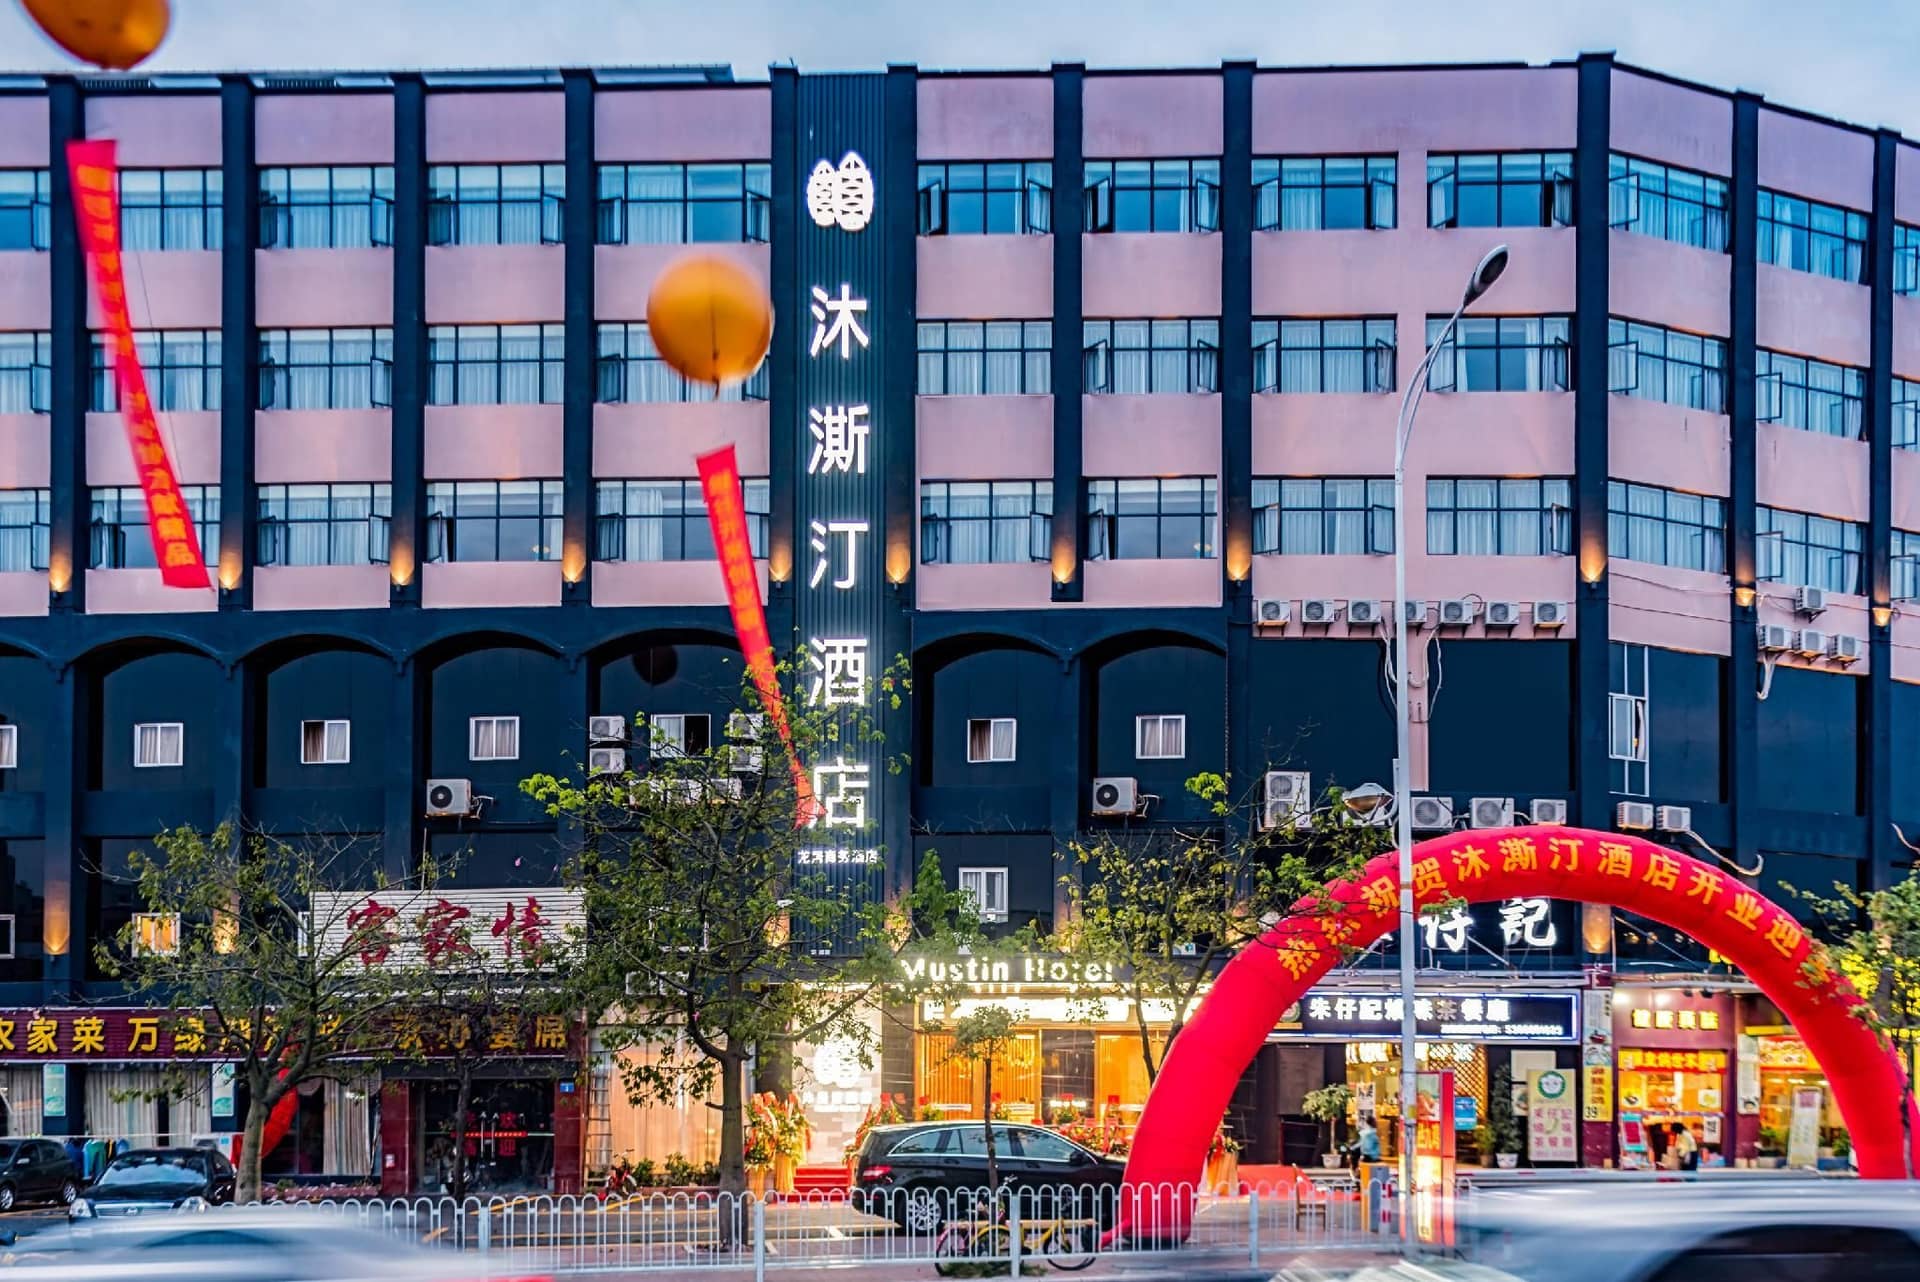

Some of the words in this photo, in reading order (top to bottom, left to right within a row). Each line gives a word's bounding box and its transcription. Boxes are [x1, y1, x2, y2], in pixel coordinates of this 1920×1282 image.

[808, 284, 869, 828] 沐澌汀酒店
[342, 895, 551, 966] 客家情
[901, 956, 1009, 982] Mustin
[1025, 957, 1113, 982] Hotel
